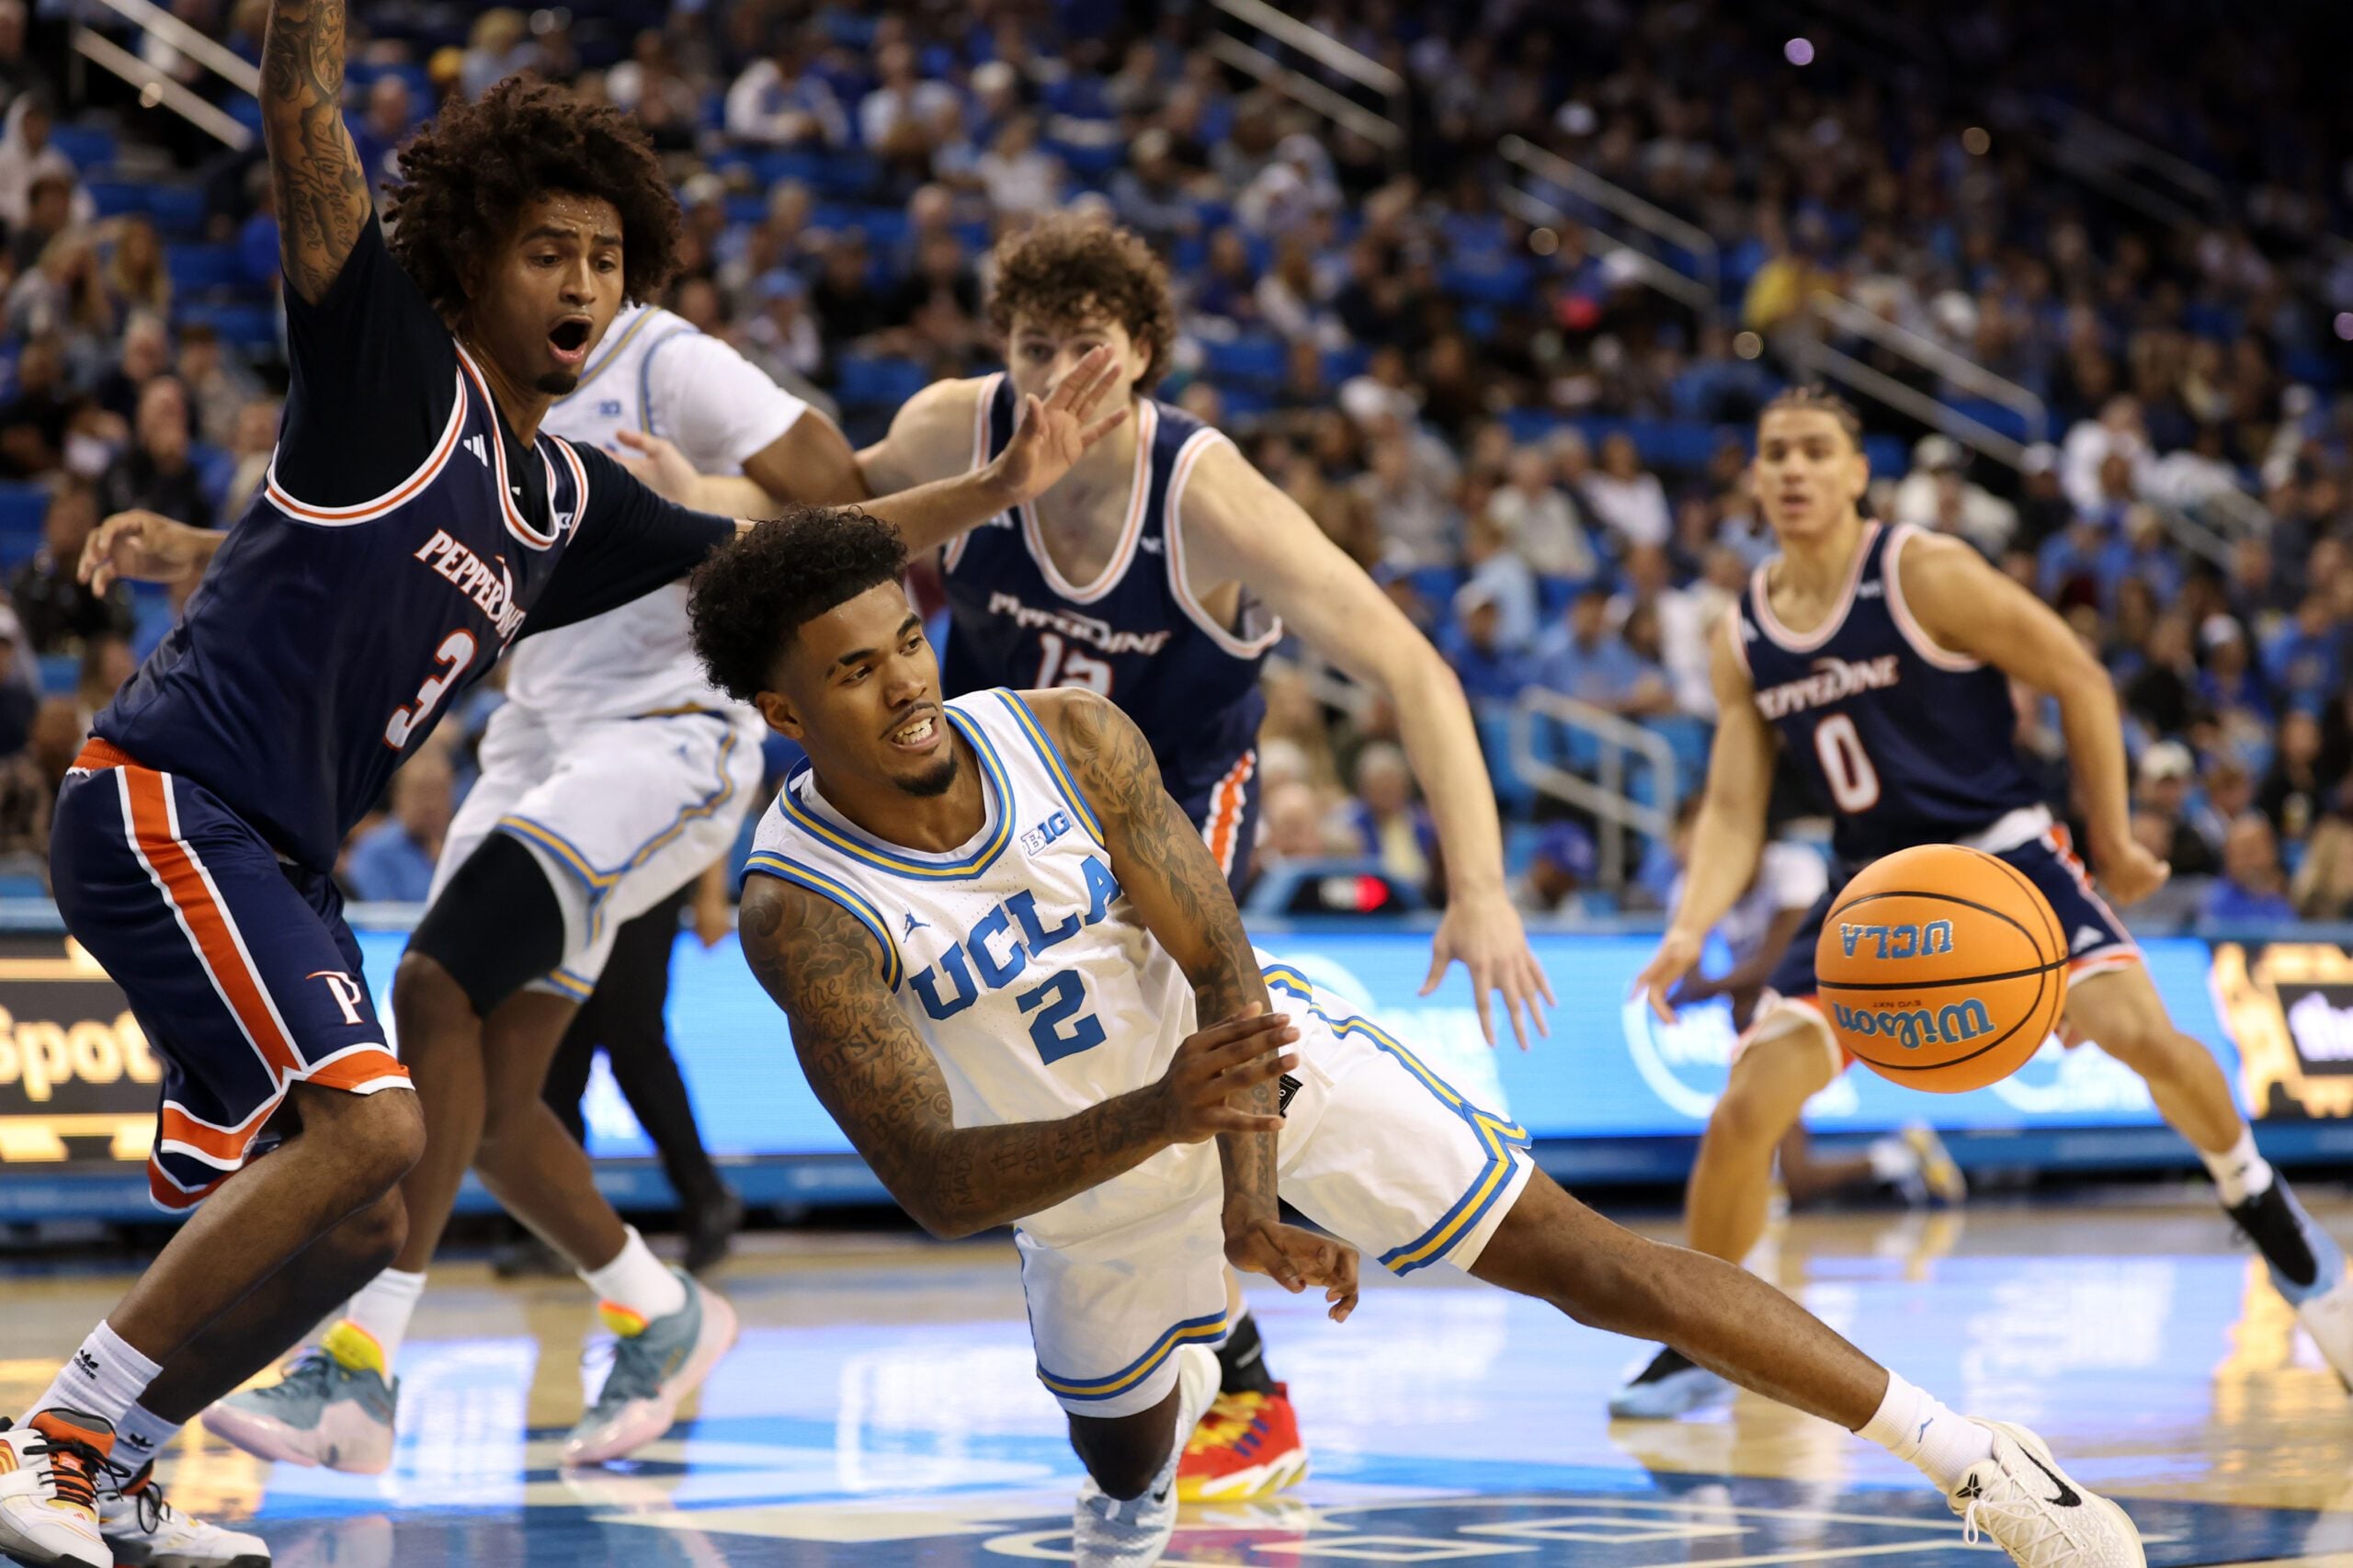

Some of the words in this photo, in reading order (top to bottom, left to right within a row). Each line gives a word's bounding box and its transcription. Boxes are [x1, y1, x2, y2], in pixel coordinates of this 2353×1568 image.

[381, 628, 478, 750] 3
[1755, 654, 1900, 721] EPPERDINE
[1814, 712, 1881, 813] 0
[908, 855, 1121, 1020] UCLA
[1839, 919, 1954, 959] UCLA
[305, 970, 365, 1025] P
[1016, 970, 1107, 1066] 2
[1832, 997, 1995, 1050] Wilson
